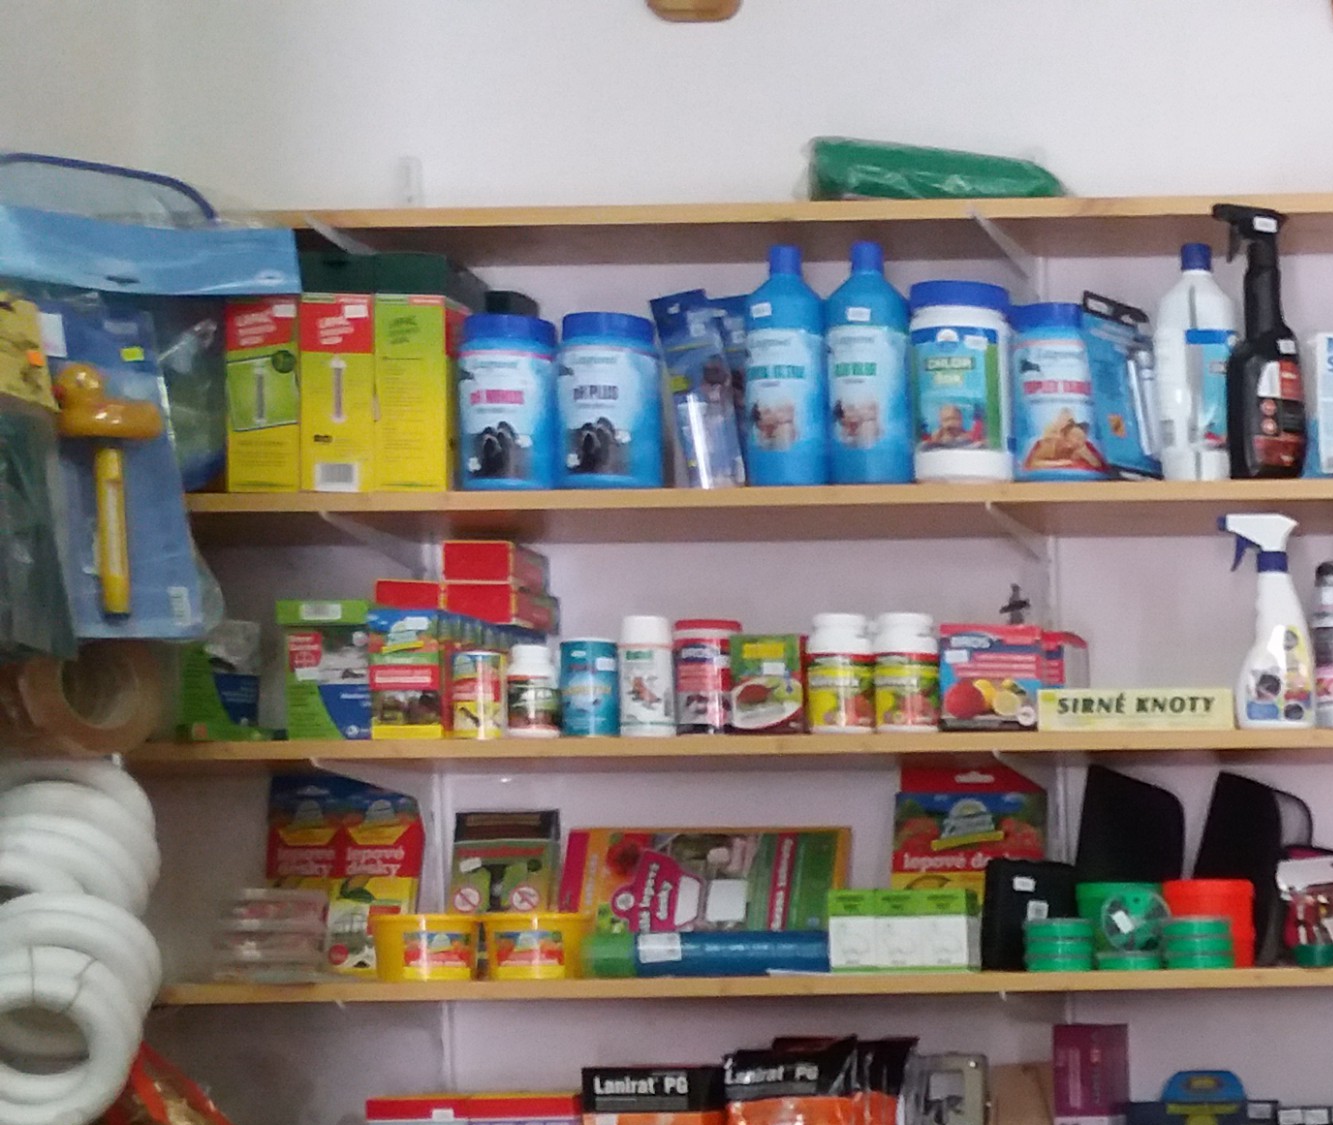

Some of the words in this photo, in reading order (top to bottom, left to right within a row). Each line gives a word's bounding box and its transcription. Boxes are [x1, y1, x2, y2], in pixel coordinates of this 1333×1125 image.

[1057, 692, 1126, 715] SIRNÉ
[1135, 696, 1216, 714] KNOTY
[593, 1076, 656, 1095] Lanirat
